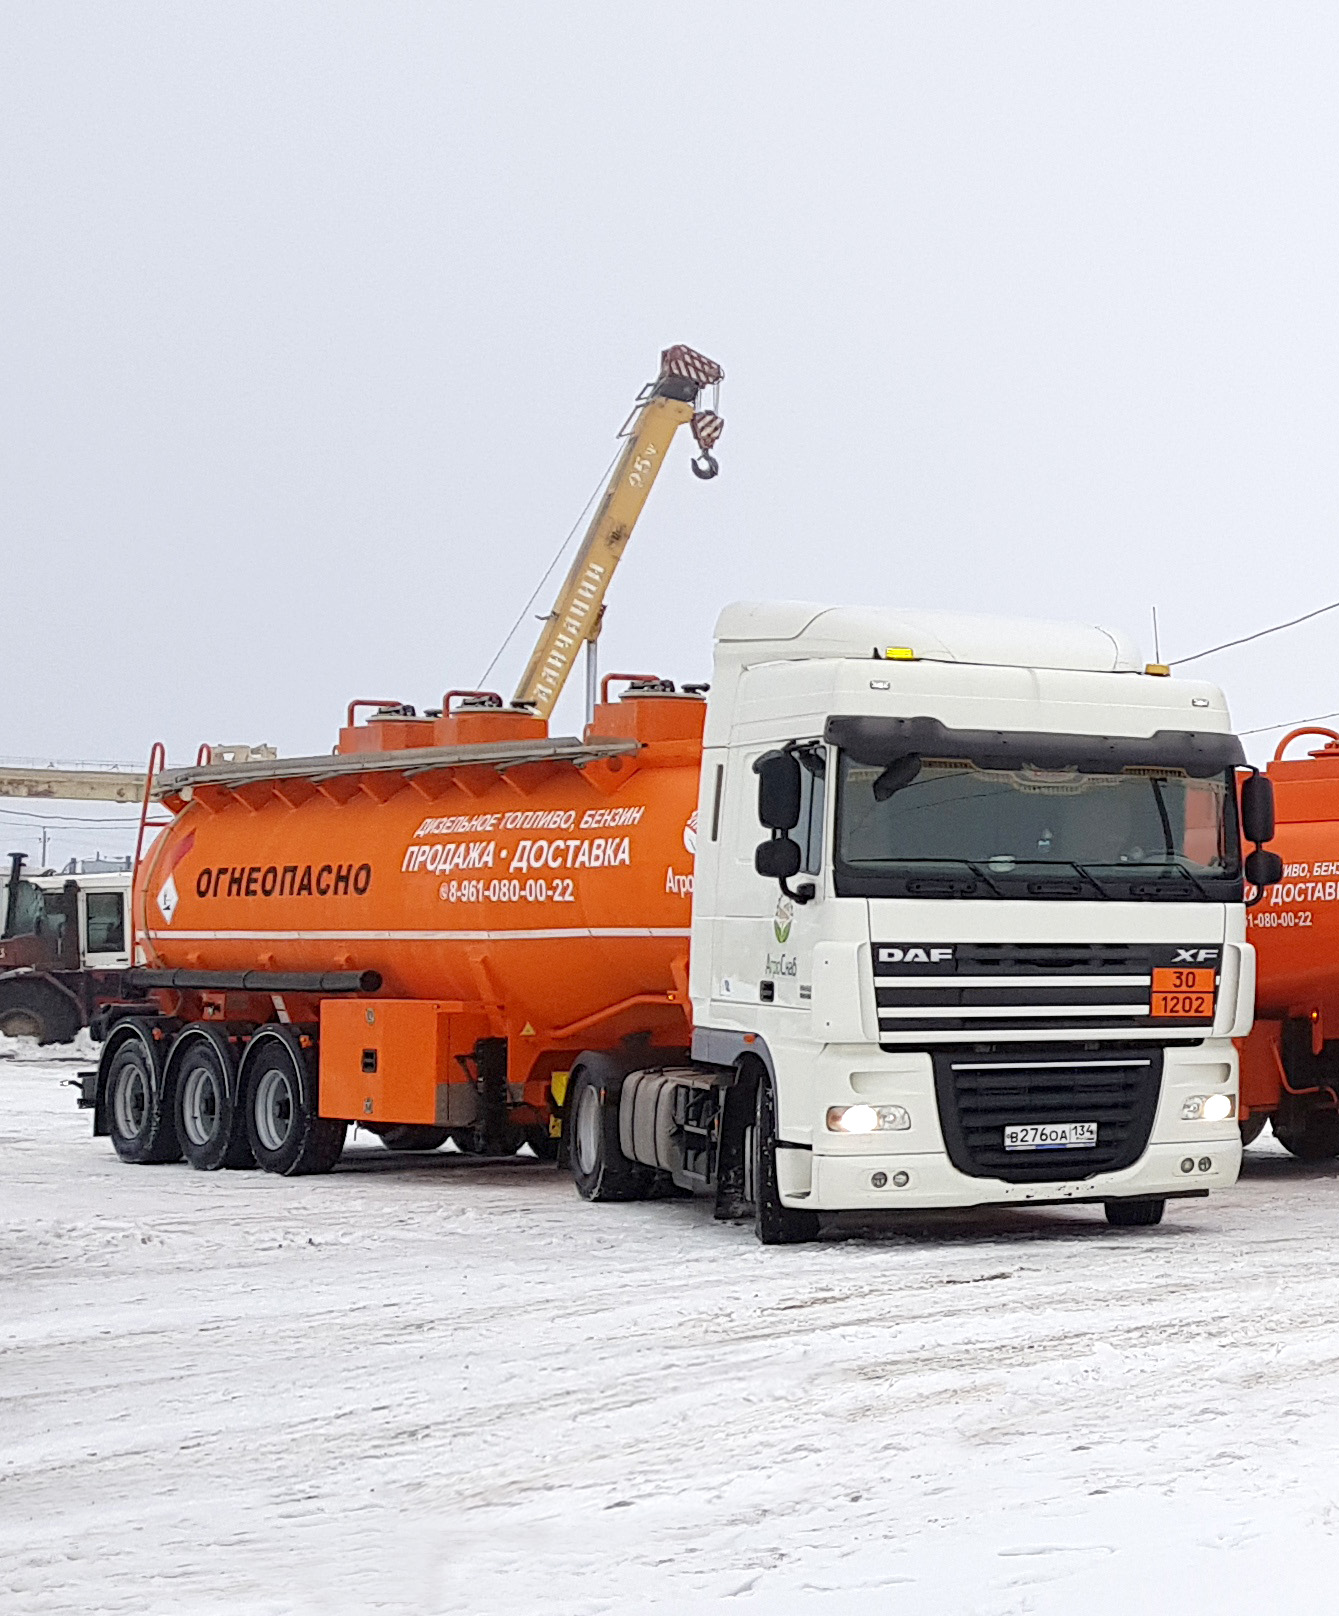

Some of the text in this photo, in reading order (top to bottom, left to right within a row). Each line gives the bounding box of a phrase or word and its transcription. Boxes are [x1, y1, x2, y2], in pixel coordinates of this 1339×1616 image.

[413, 805, 645, 838] ДИЗЕЛЬНОЕ ТОПЛИВО, БЕНЗИН
[402, 837, 630, 875] ПРОДАЖА ДОСТАВКА
[196, 863, 371, 898] ОГНЕОПАСНО
[449, 879, 575, 902] 8-961-080-00-22
[666, 867, 694, 898] Агро
[1245, 911, 1312, 928] 1-080-00-22
[879, 948, 1219, 963] DAF XF
[1173, 971, 1196, 989] 30
[1162, 996, 1205, 1015] 1202
